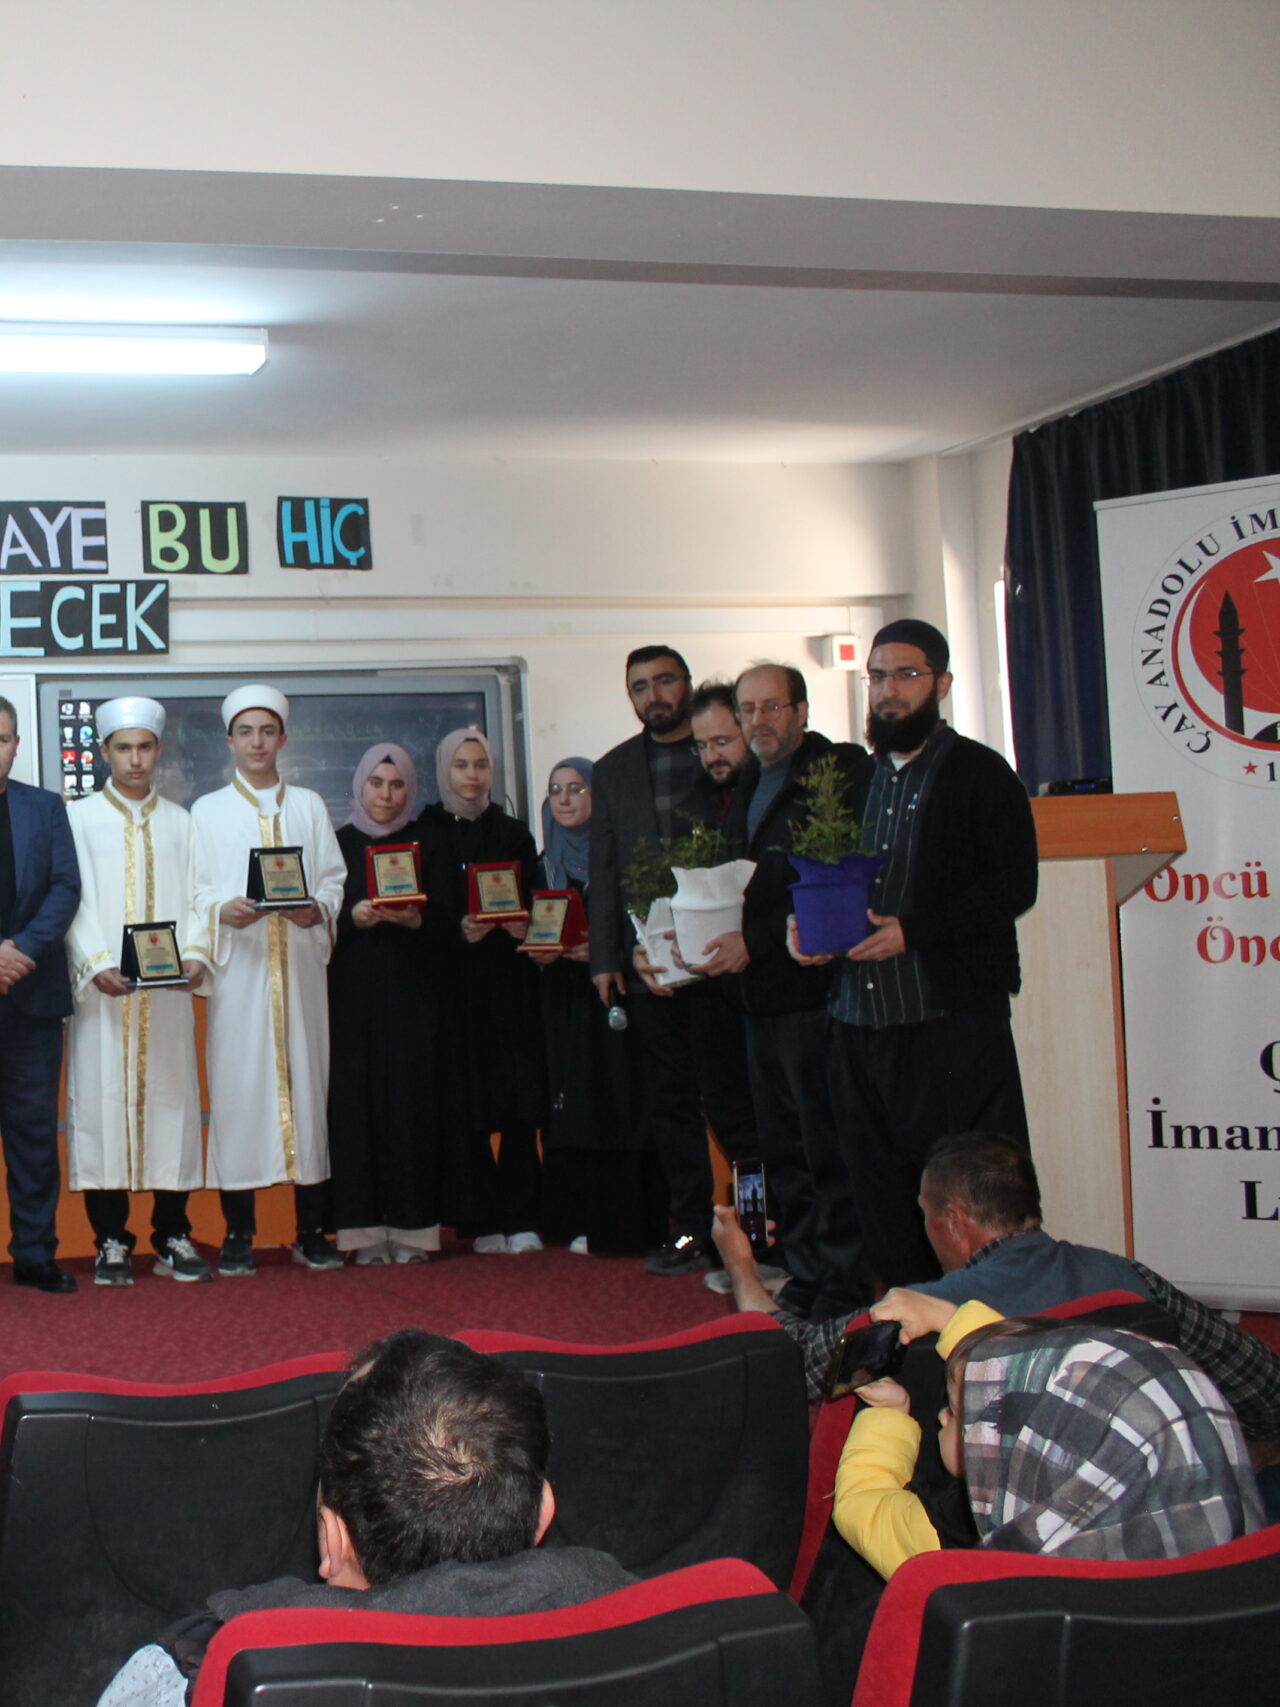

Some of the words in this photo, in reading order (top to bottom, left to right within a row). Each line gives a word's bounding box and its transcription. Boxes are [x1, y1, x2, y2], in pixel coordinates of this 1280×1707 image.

[149, 503, 240, 573] BU
[281, 498, 366, 566] HİÇ
[1140, 532, 1221, 688] ANADOLU
[1154, 701, 1212, 754] ÇAY
